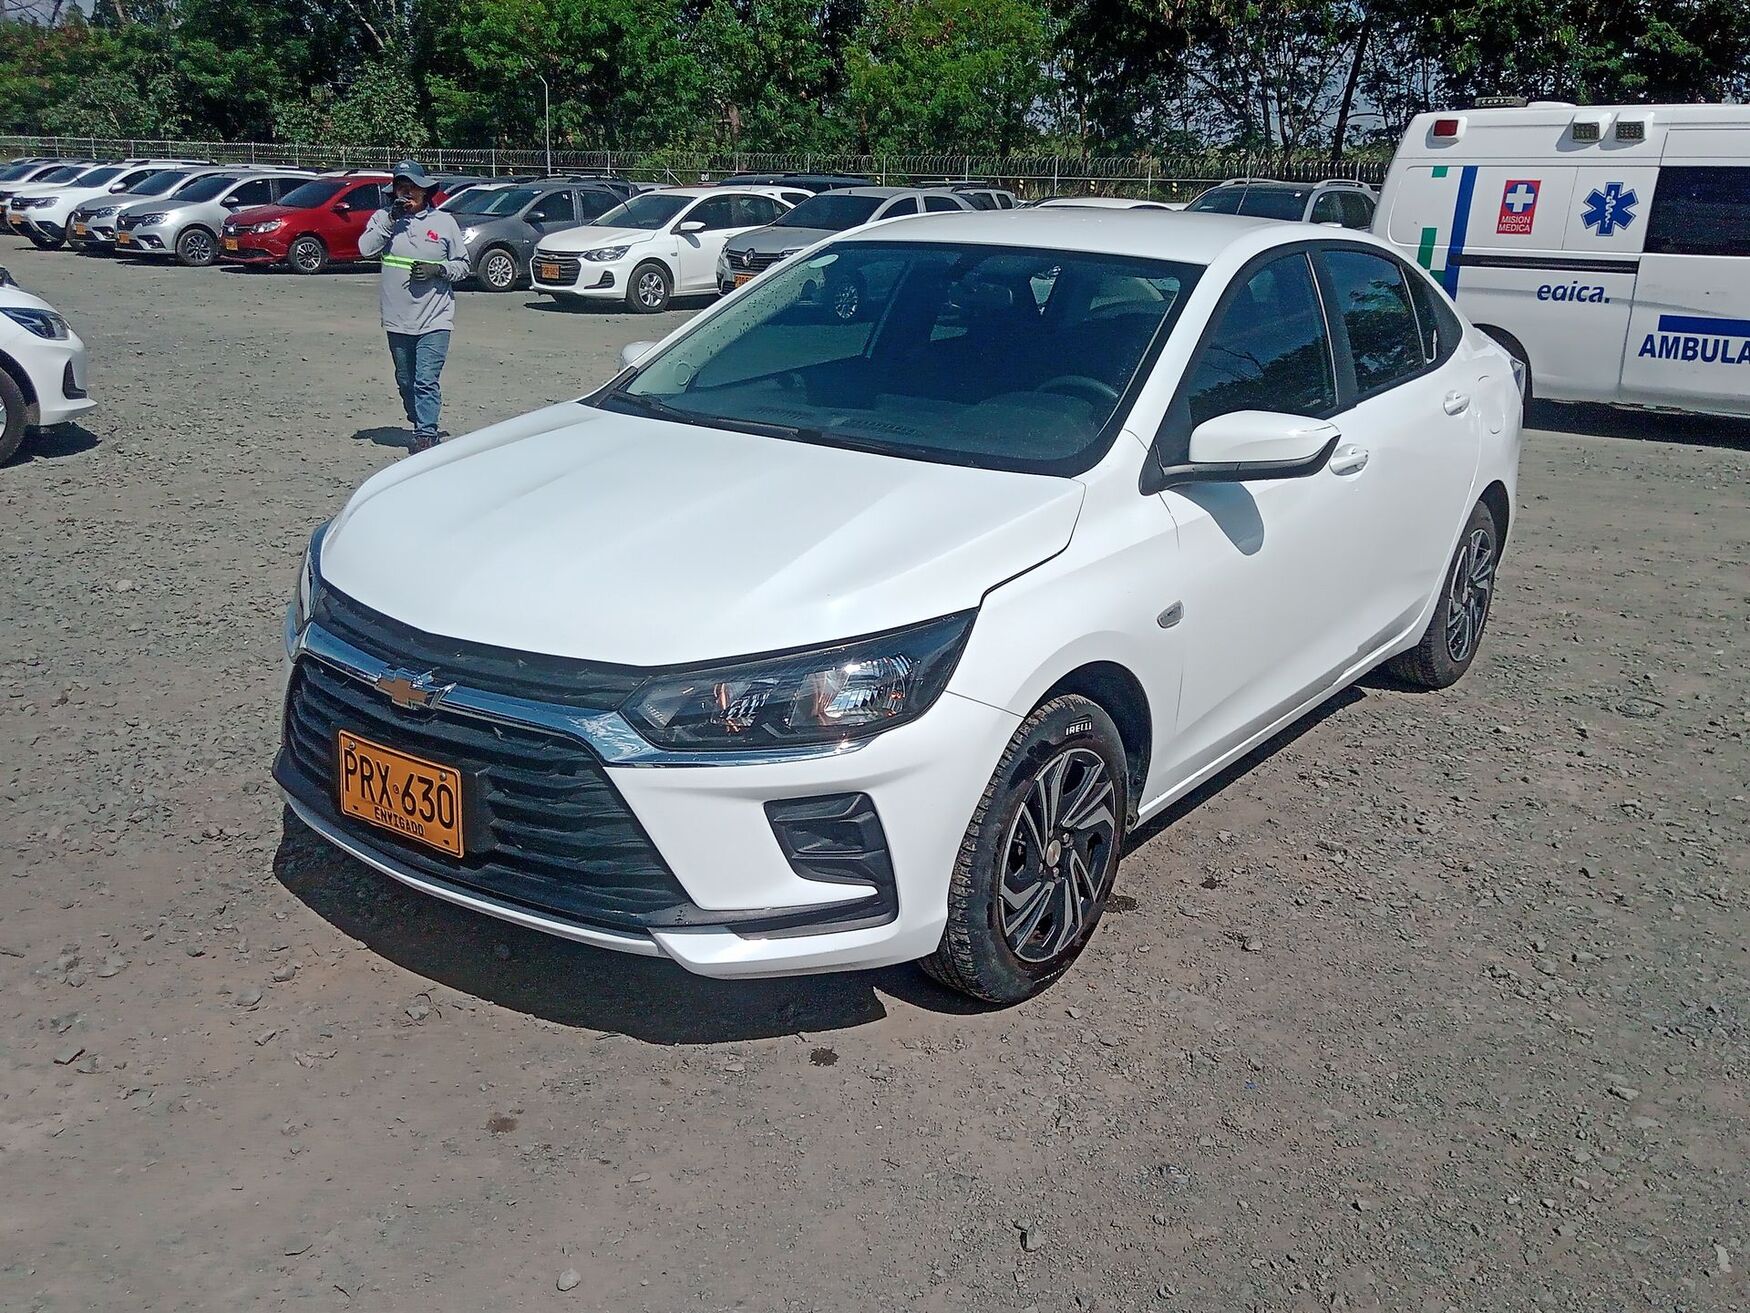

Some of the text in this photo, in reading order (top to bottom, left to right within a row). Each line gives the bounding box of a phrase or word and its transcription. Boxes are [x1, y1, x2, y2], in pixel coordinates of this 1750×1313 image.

[1498, 223, 1531, 233] MEDICA
[1501, 215, 1531, 224] MISION
[1638, 333, 1750, 365] AMBULA
[374, 806, 426, 836] ENVIGADO
